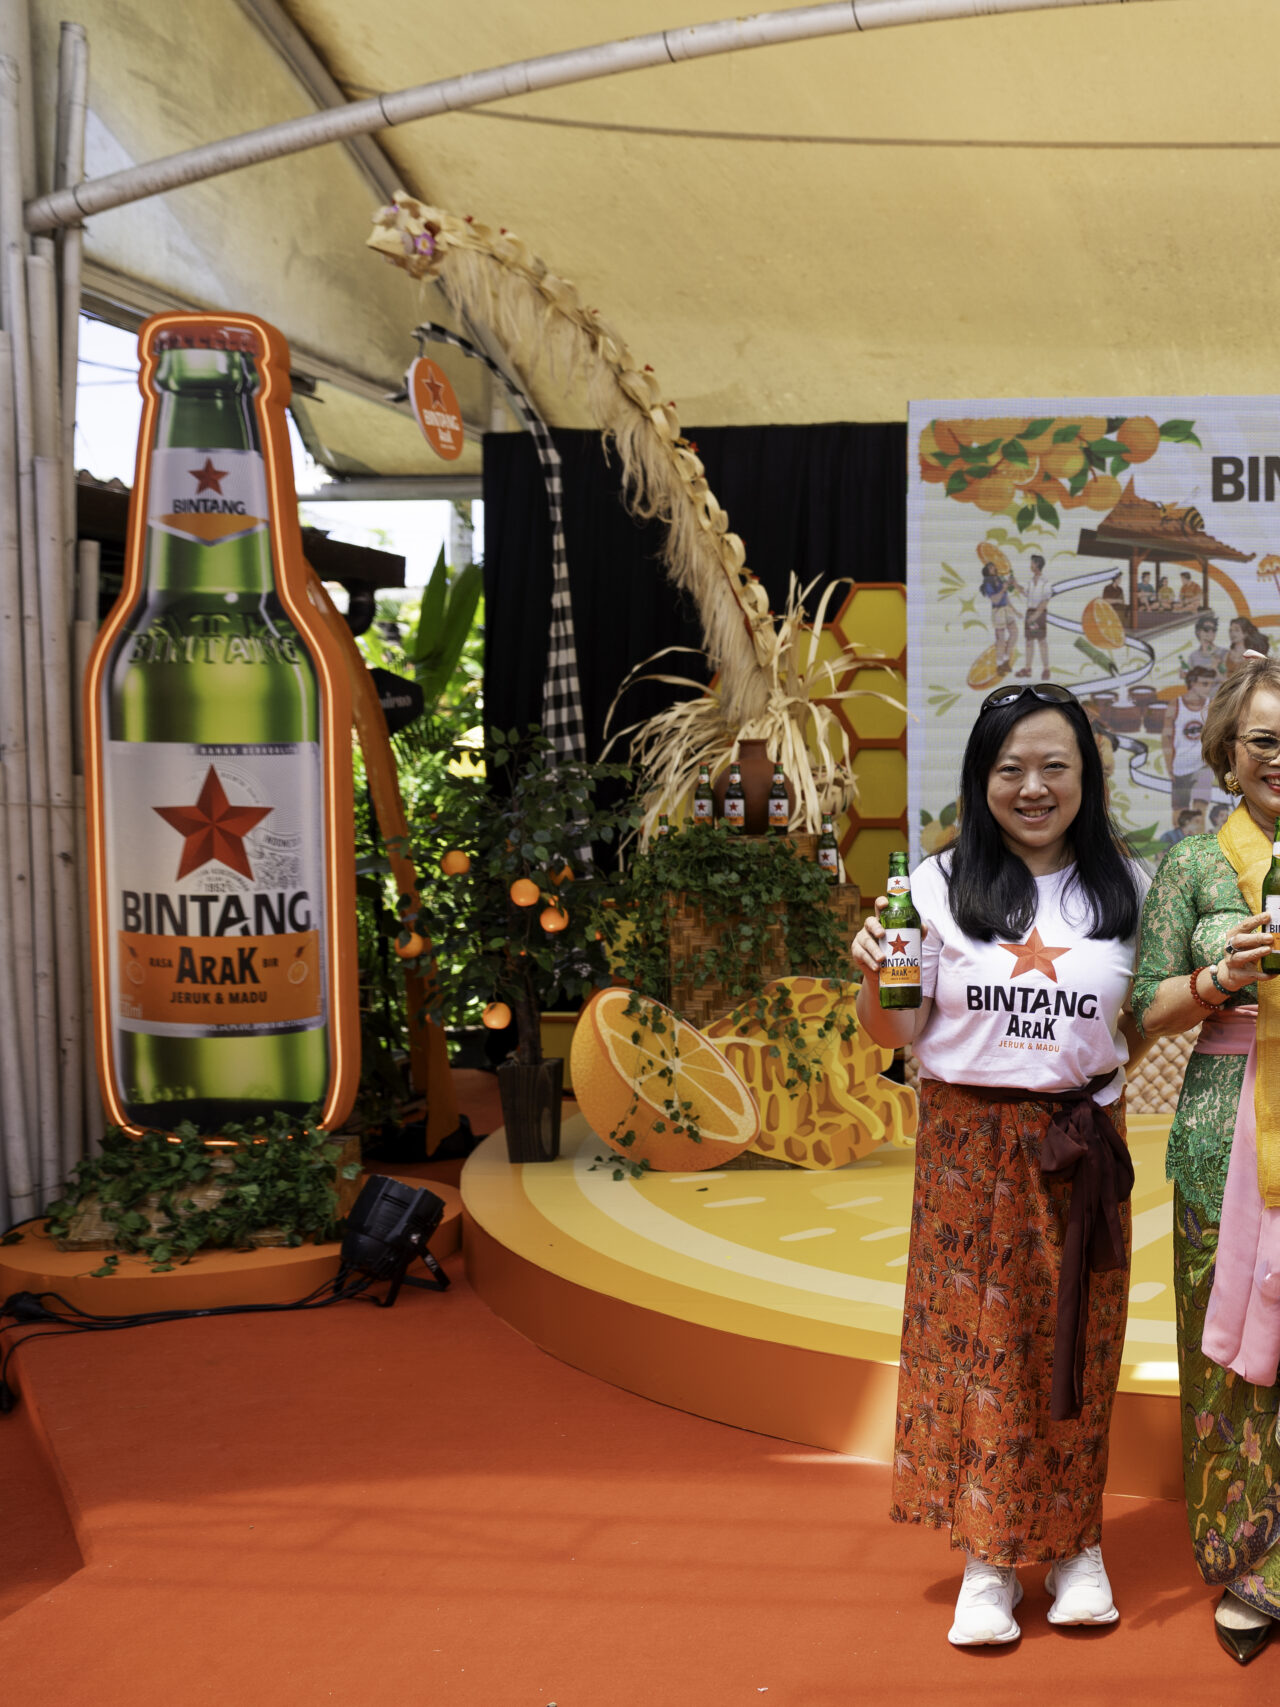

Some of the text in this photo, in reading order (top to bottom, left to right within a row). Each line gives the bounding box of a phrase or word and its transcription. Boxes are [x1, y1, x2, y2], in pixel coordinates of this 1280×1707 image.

[172, 499, 247, 515] BINTANG
[122, 890, 311, 937] BINTANG
[262, 958, 278, 968] BIR
[170, 991, 268, 1005] JERUK & MADU
[966, 985, 1099, 1020] BINTANG
[998, 1040, 1060, 1053] JERUK & MADU
